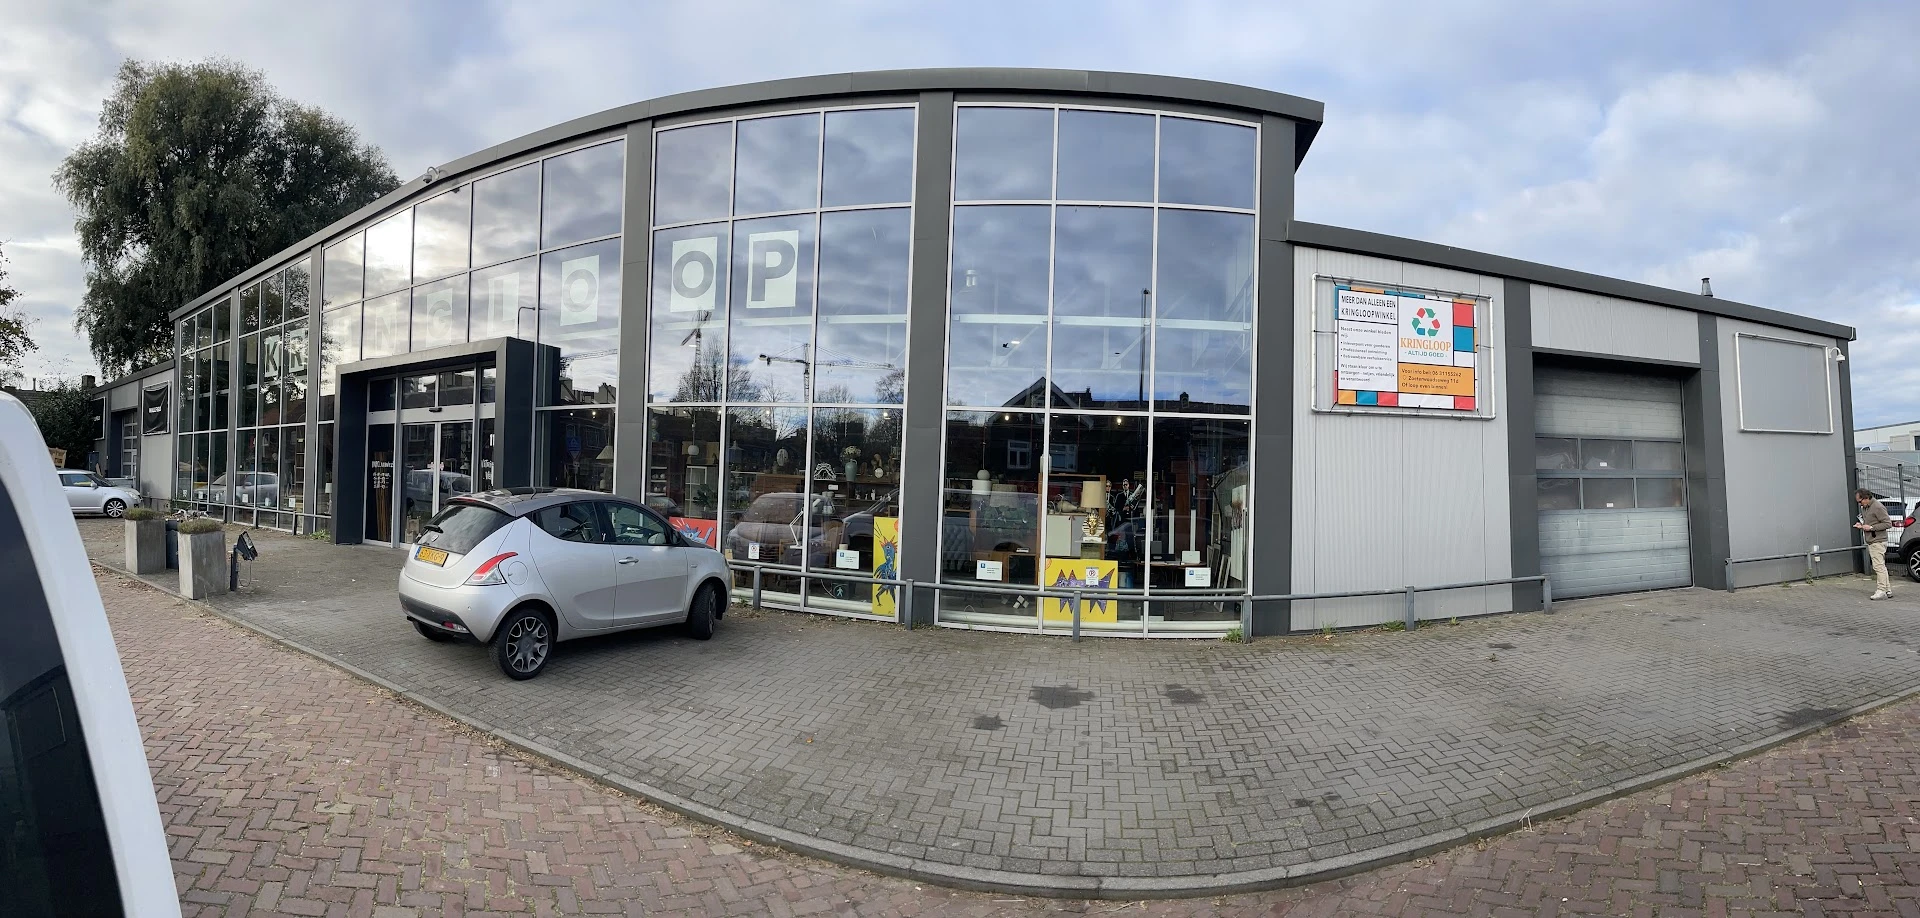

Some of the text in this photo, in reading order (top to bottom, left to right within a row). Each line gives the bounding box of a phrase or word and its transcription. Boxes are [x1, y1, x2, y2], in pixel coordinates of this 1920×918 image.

[1342, 295, 1355, 304] MEER
[1356, 297, 1367, 305] DAN
[1368, 298, 1386, 306] ALLEEN
[1342, 308, 1396, 320] KRINGLOOPWINKEL
[1400, 338, 1451, 352] KRINGLOOP
